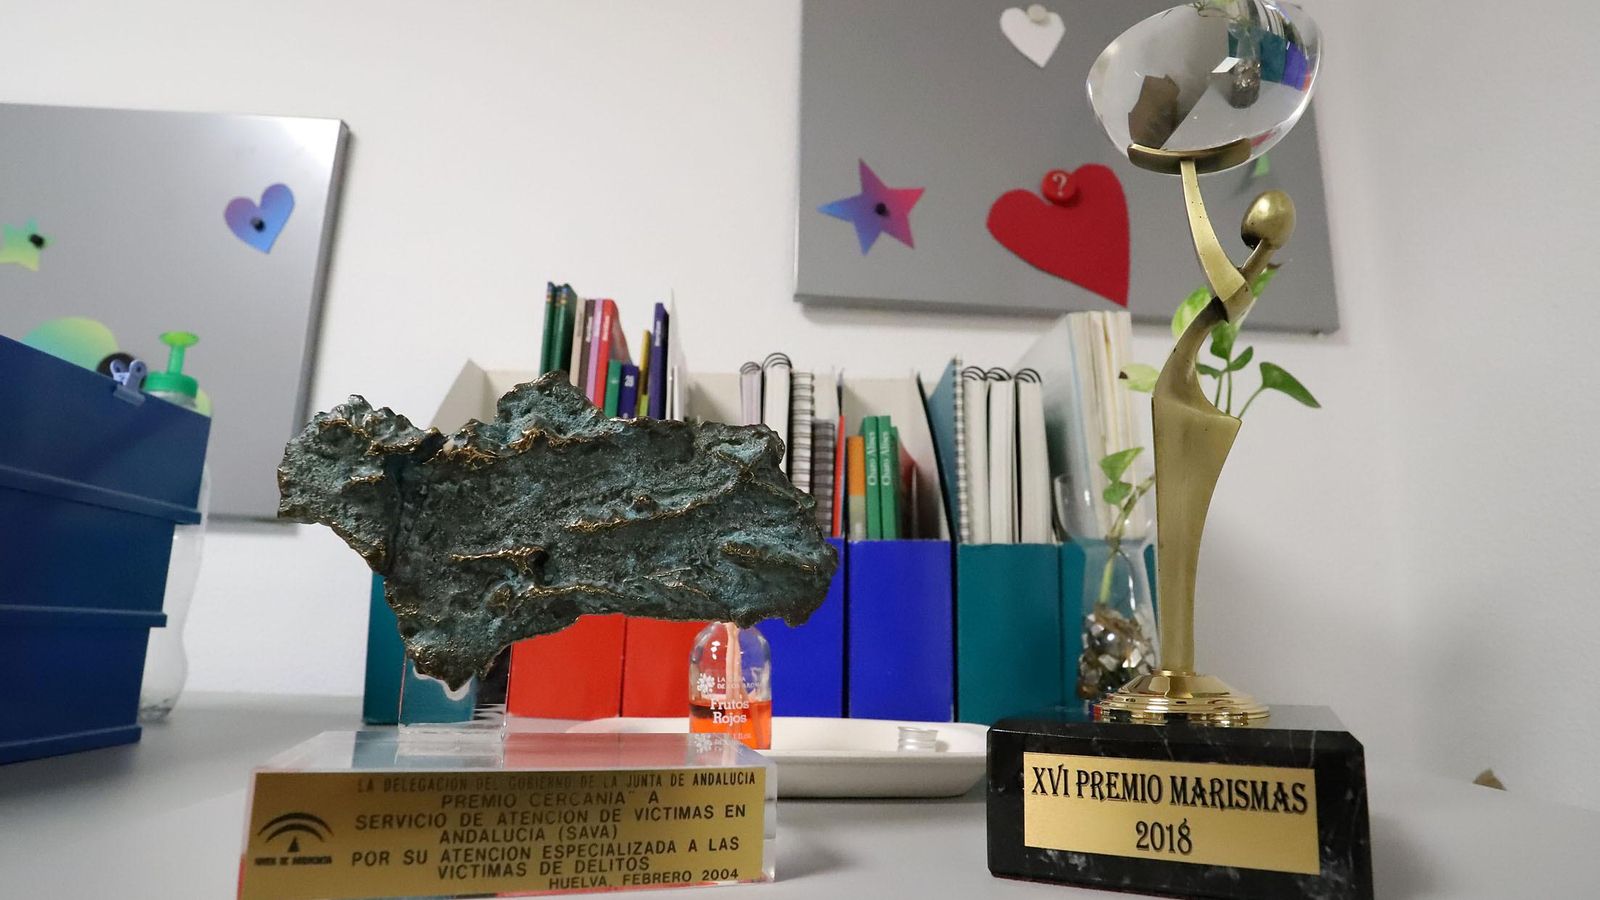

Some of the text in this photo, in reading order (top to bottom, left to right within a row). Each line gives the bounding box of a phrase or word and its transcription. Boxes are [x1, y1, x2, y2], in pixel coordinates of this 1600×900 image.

[1052, 173, 1067, 197] ?
[710, 699, 749, 710] Frutos
[712, 711, 747, 726] Rojos
[357, 778, 375, 793] LA
[383, 777, 467, 793] DELEGACION
[508, 775, 573, 791] GOBIERNO
[580, 775, 594, 789] DE
[603, 775, 617, 789] LA
[627, 773, 662, 789] JUNTA
[670, 773, 685, 787] DE
[692, 771, 756, 786] ANDALUCIA
[1030, 762, 1308, 815] XVI PREMIO MARISMAS
[441, 793, 517, 809] PREMIO
[648, 790, 659, 804] A
[355, 804, 746, 831] SERVICIO DE ATENCION DE VICTIMAS EN
[439, 824, 618, 845] ANDALUCIA (SAVA)
[1134, 817, 1194, 856] 2018
[351, 850, 391, 867] POR
[402, 849, 428, 866] SU
[440, 845, 532, 864] ATENCION
[542, 840, 677, 860] ESPECIALIZADA
[687, 838, 698, 853] A
[708, 836, 740, 852] LAS
[438, 856, 650, 881] VICTIMAS DE DELITOS
[622, 870, 692, 886] FEBRERO
[702, 868, 739, 882] 2004
